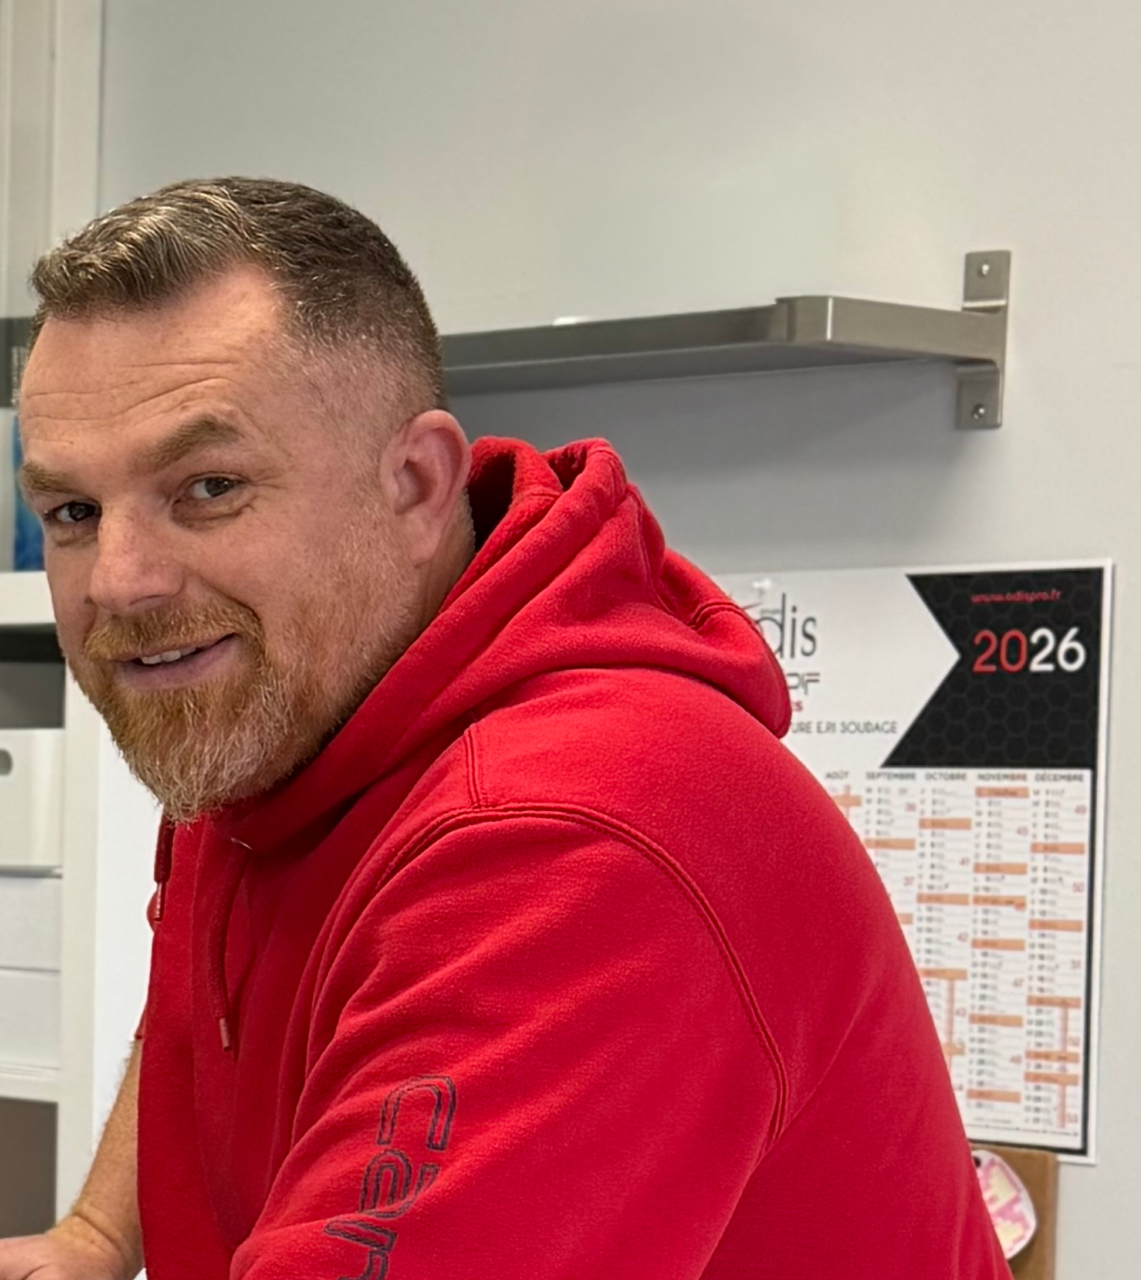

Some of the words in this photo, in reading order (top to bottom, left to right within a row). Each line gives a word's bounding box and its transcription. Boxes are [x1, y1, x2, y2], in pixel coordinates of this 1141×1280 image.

[755, 592, 818, 659] dis
[972, 626, 1087, 673] 2026
[790, 721, 812, 734] URE
[840, 721, 898, 734] SOUDAGE
[865, 771, 916, 781] SEPTEMBRE
[924, 771, 967, 781] OCTOBRE
[977, 773, 1028, 782] NOVEMBRE
[1034, 771, 1084, 783] DÉCEMBRE
